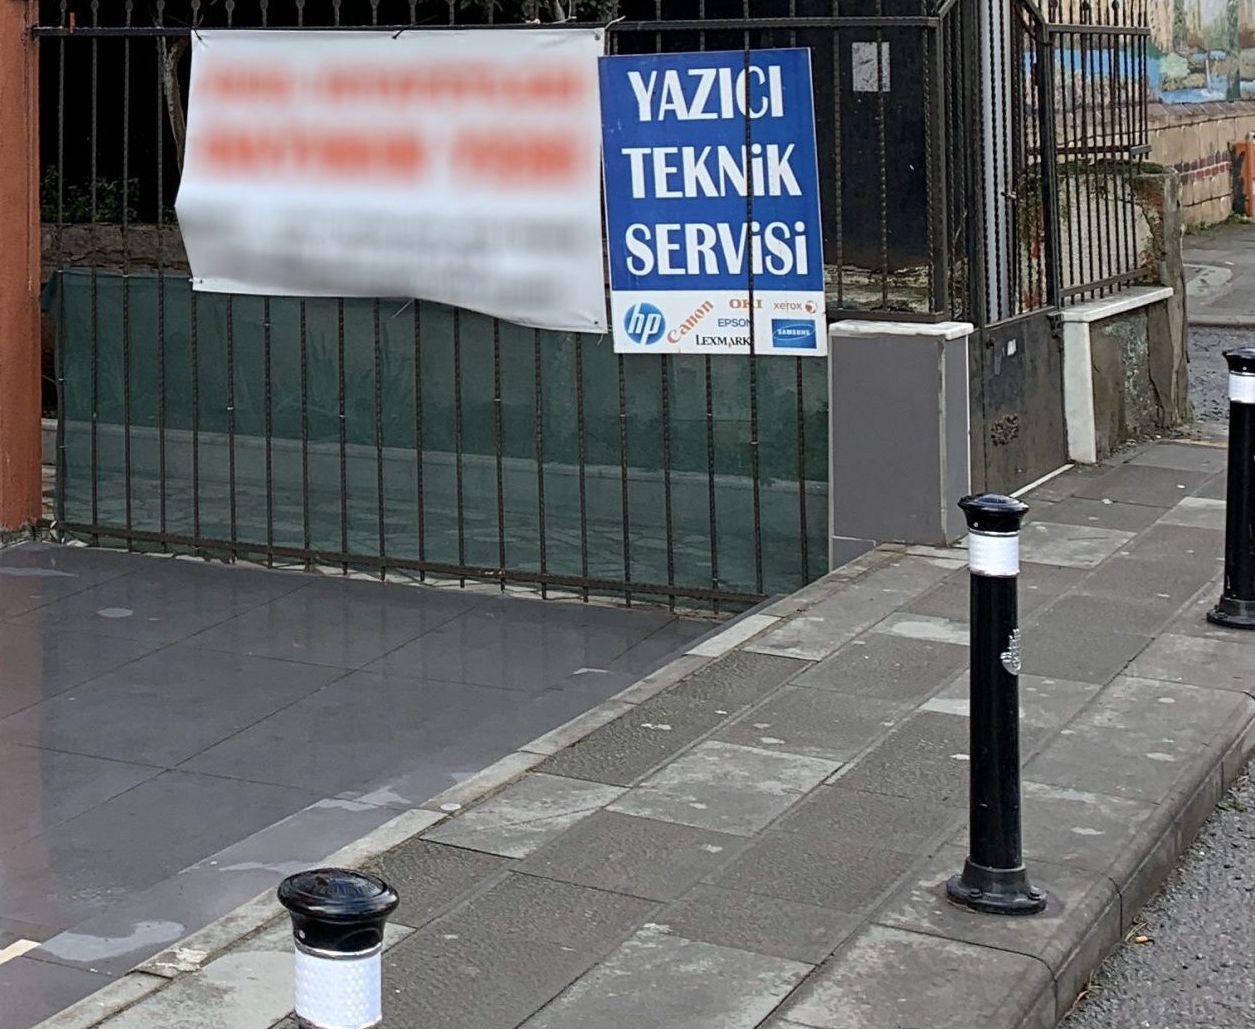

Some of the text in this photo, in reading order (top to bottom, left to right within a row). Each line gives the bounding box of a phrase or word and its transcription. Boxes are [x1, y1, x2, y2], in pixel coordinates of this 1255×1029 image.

[628, 65, 783, 121] YAZICI
[626, 304, 662, 345] hp
[667, 299, 714, 345] Canon
[773, 301, 802, 310] xerox
[777, 328, 811, 336] SAMSUNG
